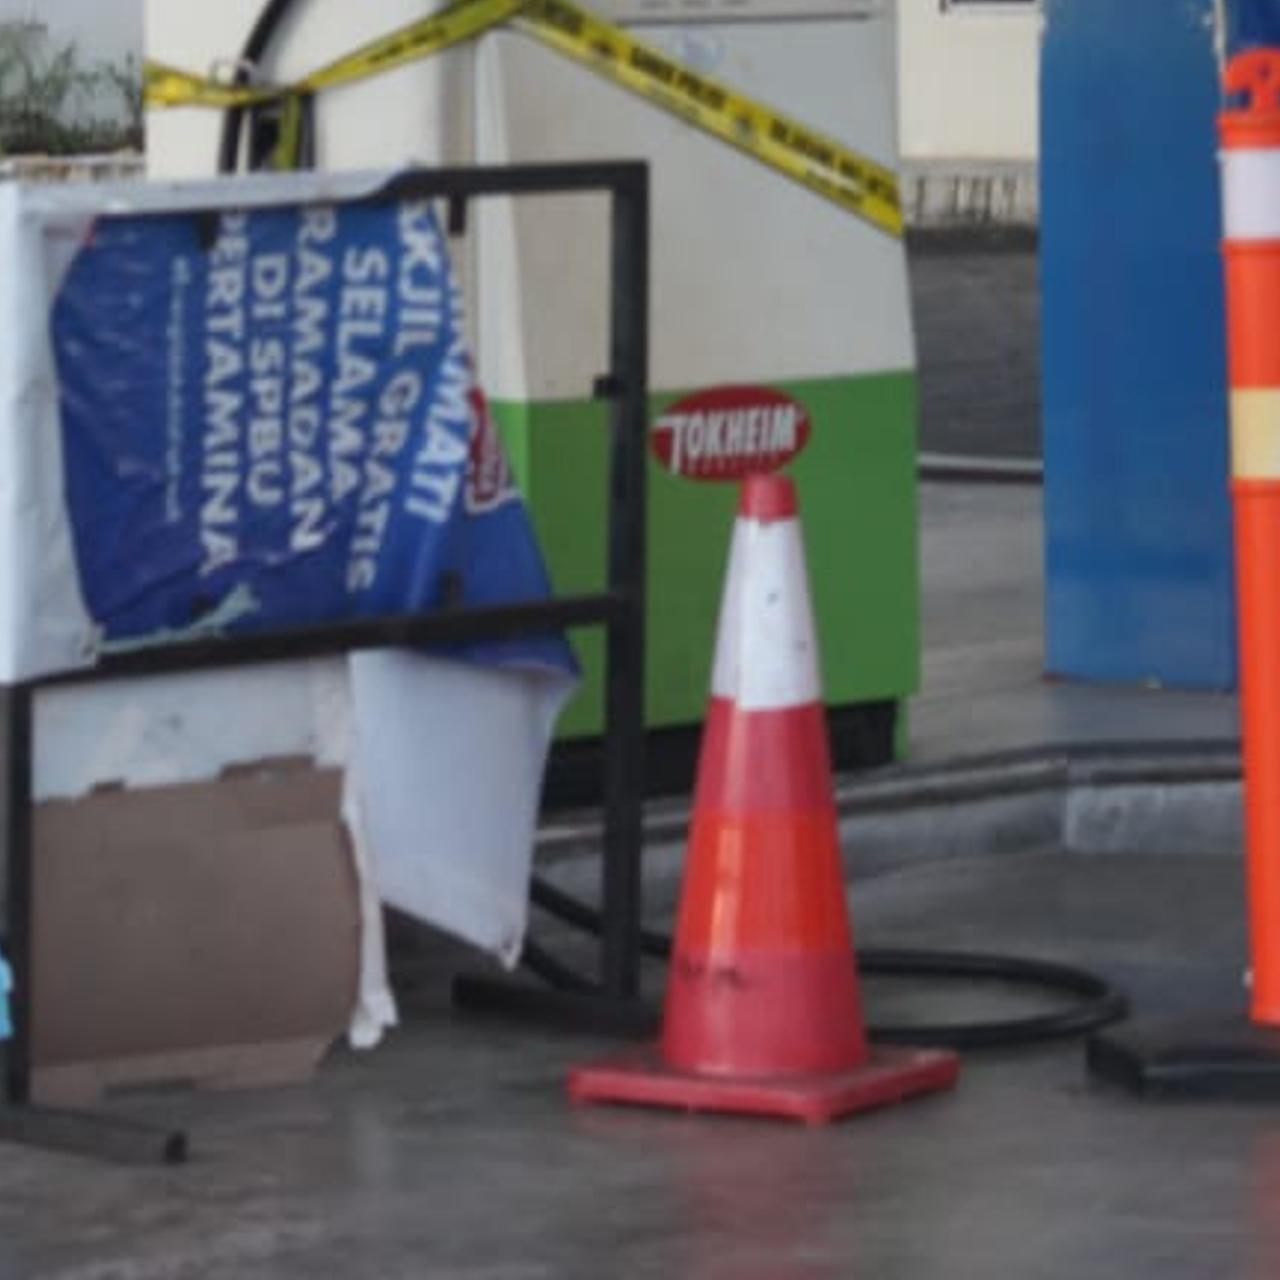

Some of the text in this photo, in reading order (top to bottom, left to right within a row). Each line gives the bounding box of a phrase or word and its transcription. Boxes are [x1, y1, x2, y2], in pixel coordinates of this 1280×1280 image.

[246, 252, 287, 506] DI SPBU
[328, 246, 387, 502] SELAMA
[347, 372, 419, 592] GRATIS
[656, 403, 798, 475] TOKHEIM
